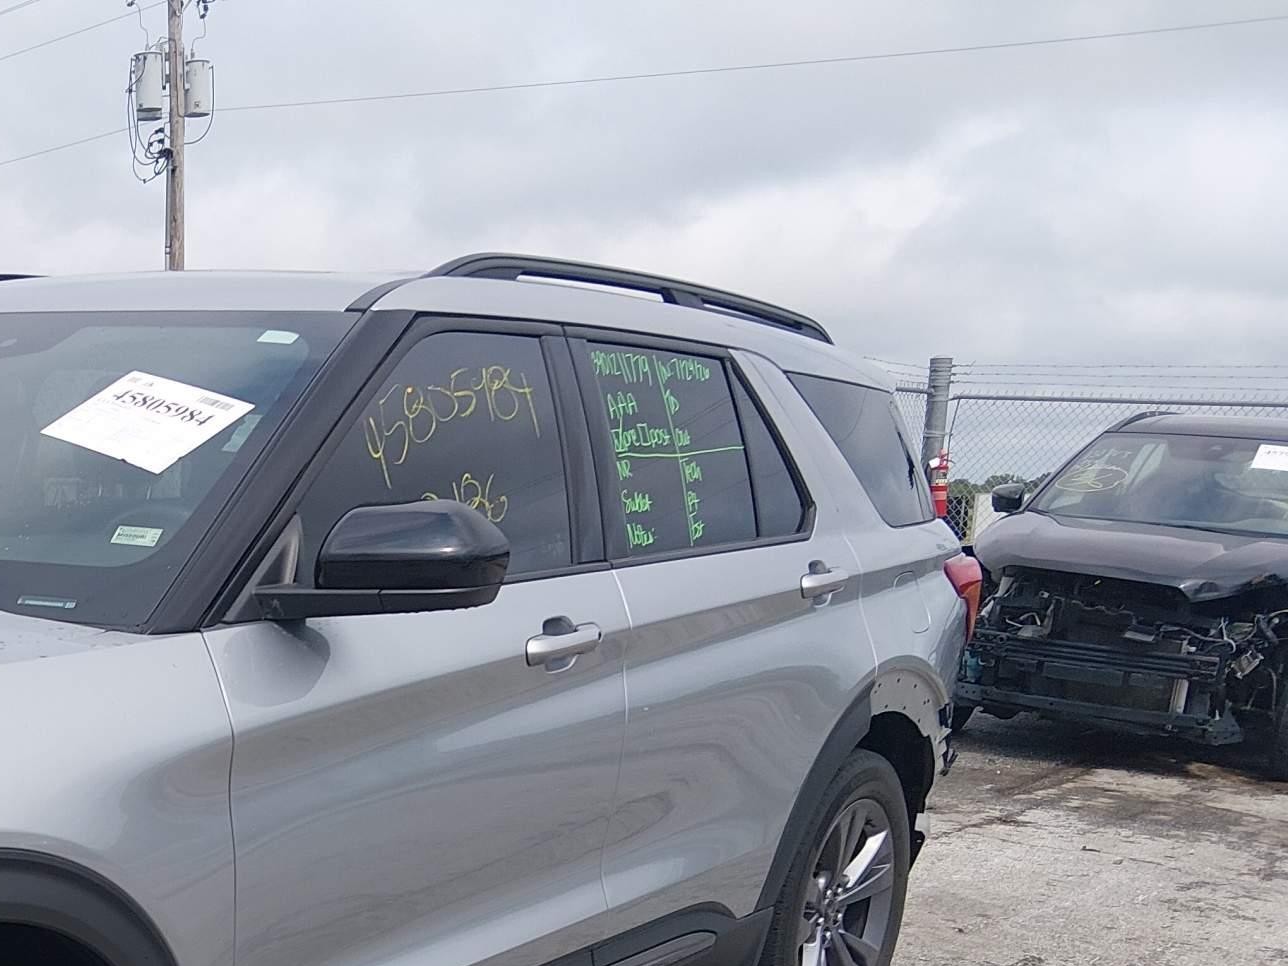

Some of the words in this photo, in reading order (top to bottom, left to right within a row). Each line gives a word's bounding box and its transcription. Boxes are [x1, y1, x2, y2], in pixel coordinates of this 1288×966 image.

[113, 389, 215, 427] 45805984
[607, 391, 638, 420] AAA
[364, 365, 542, 490] 45805984
